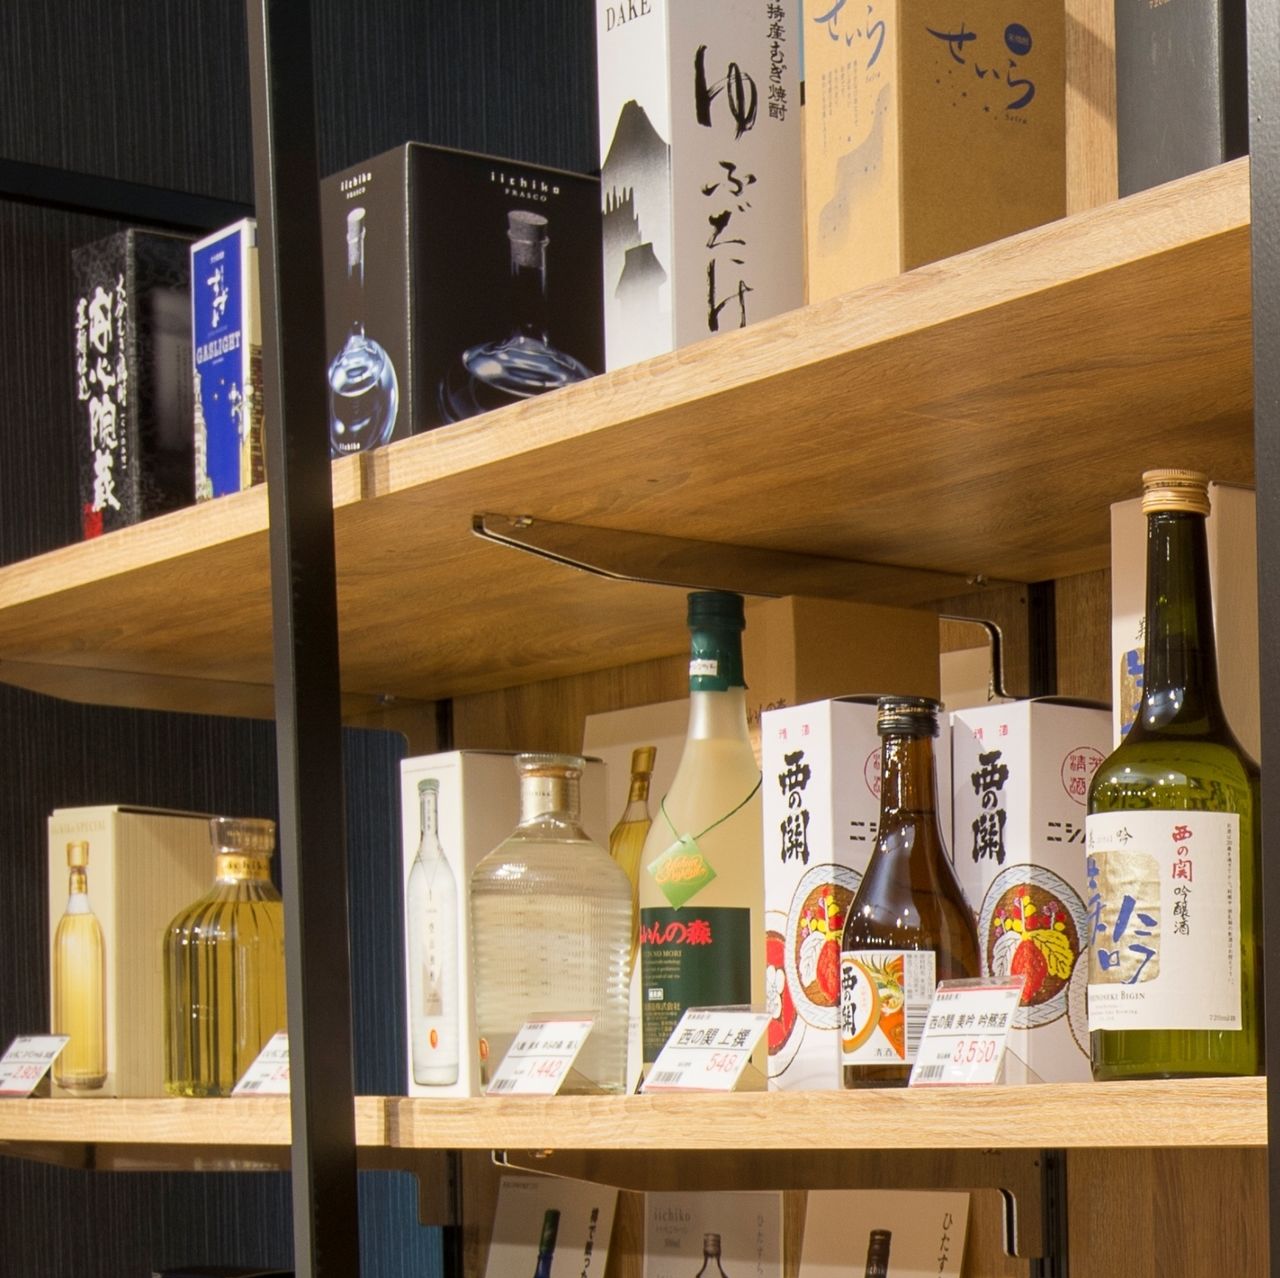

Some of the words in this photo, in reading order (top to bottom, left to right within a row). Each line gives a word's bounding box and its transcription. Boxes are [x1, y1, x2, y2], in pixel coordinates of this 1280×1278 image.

[605, 0, 652, 32] DAKE
[340, 172, 372, 192] iichiko
[490, 171, 562, 196] iichiko
[504, 187, 548, 203] FRASCO
[196, 330, 241, 365] GASLIGHT
[1172, 825, 1193, 882] 西の関
[1174, 886, 1193, 937] 吟醸酒
[705, 1052, 738, 1073] 548
